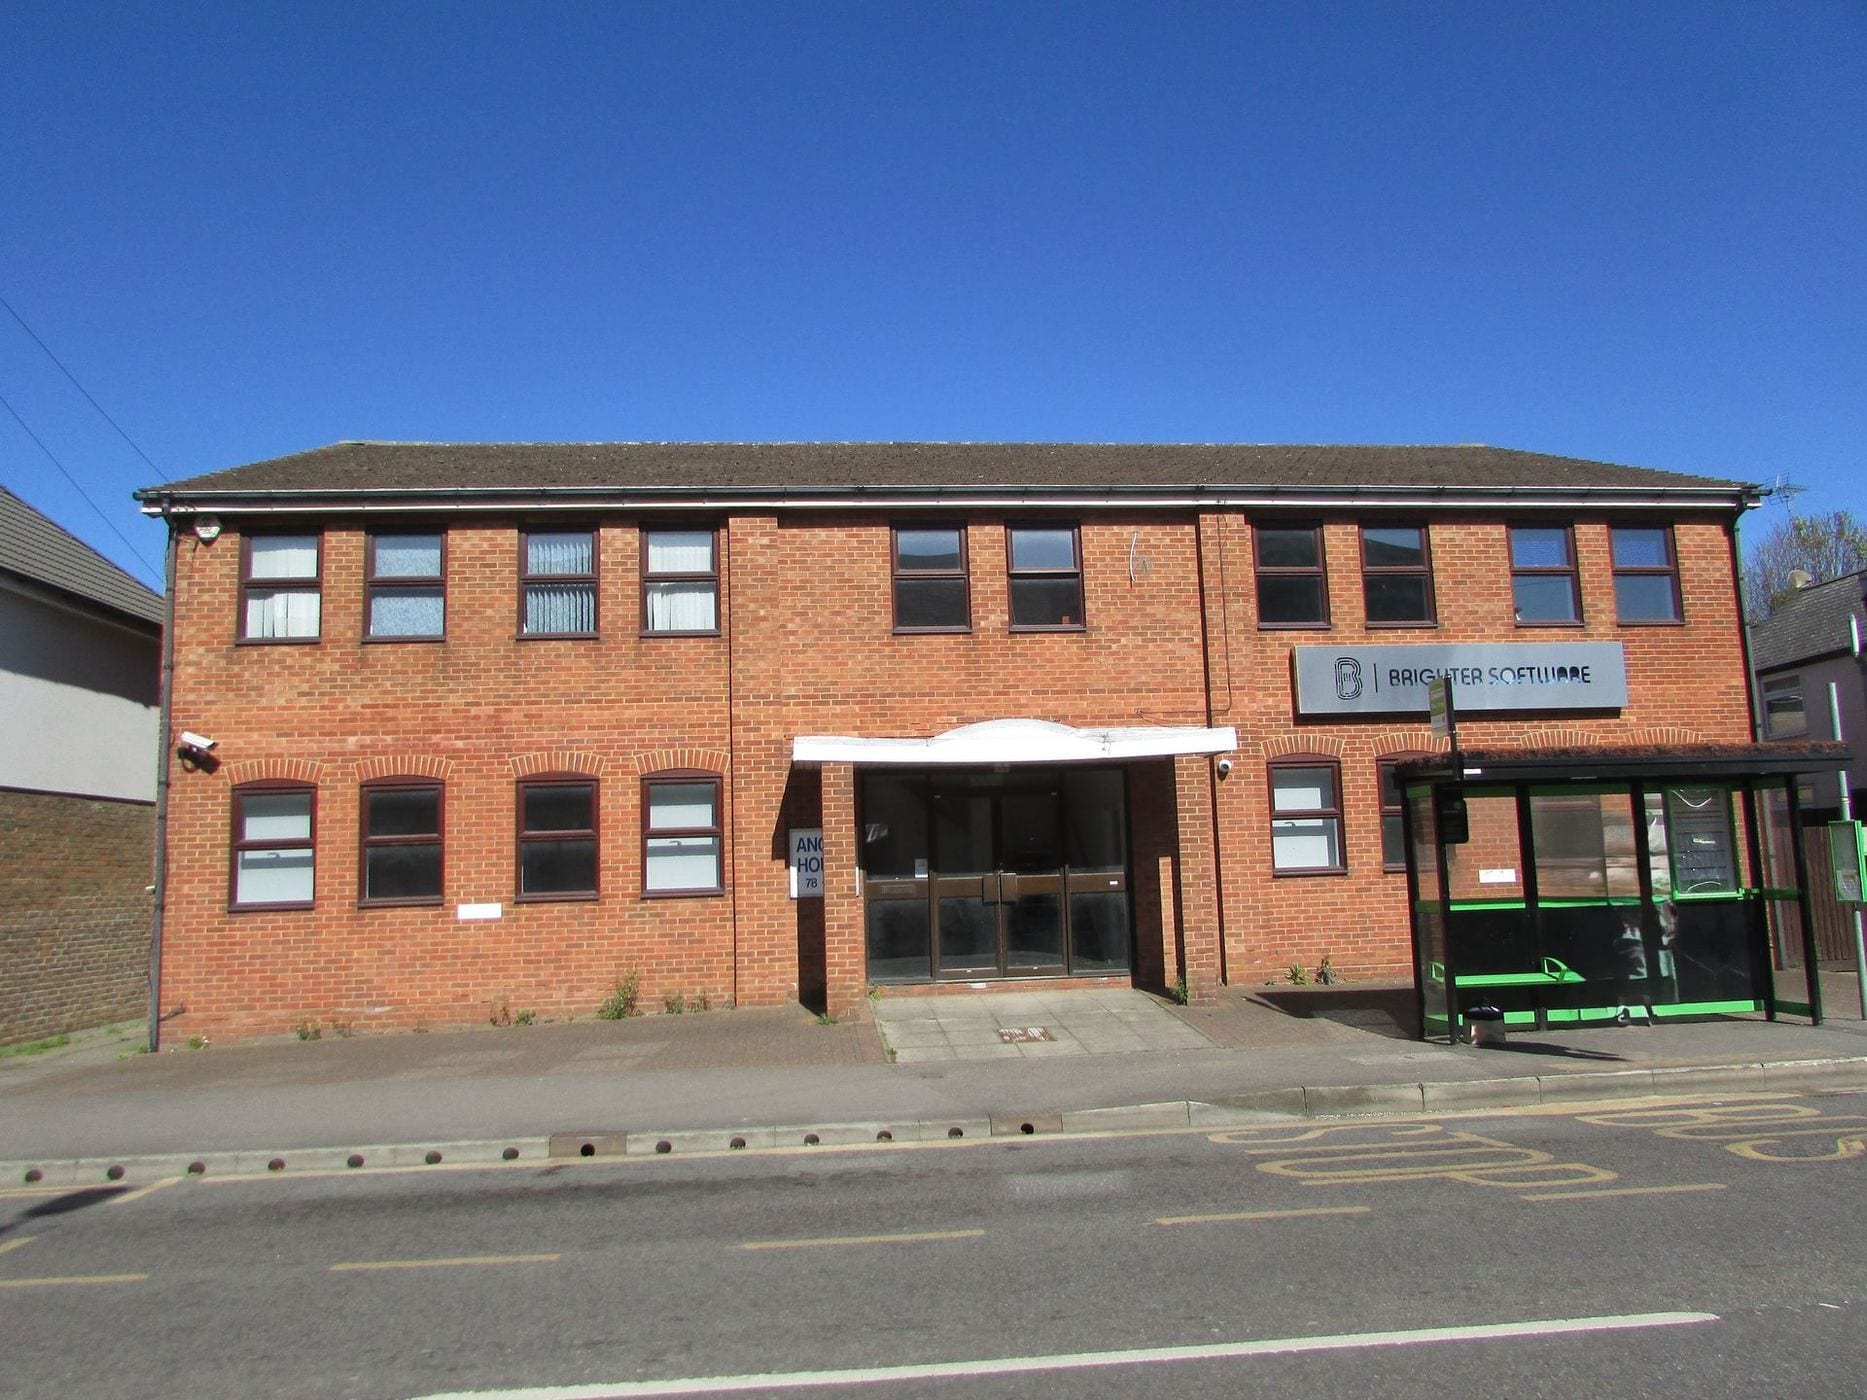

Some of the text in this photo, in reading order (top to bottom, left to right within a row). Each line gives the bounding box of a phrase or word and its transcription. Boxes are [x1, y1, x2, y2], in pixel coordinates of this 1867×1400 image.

[1389, 666, 1591, 686] BRIGHTER SOFTWARE
[797, 856, 824, 873] HO
[805, 877, 818, 889] 78
